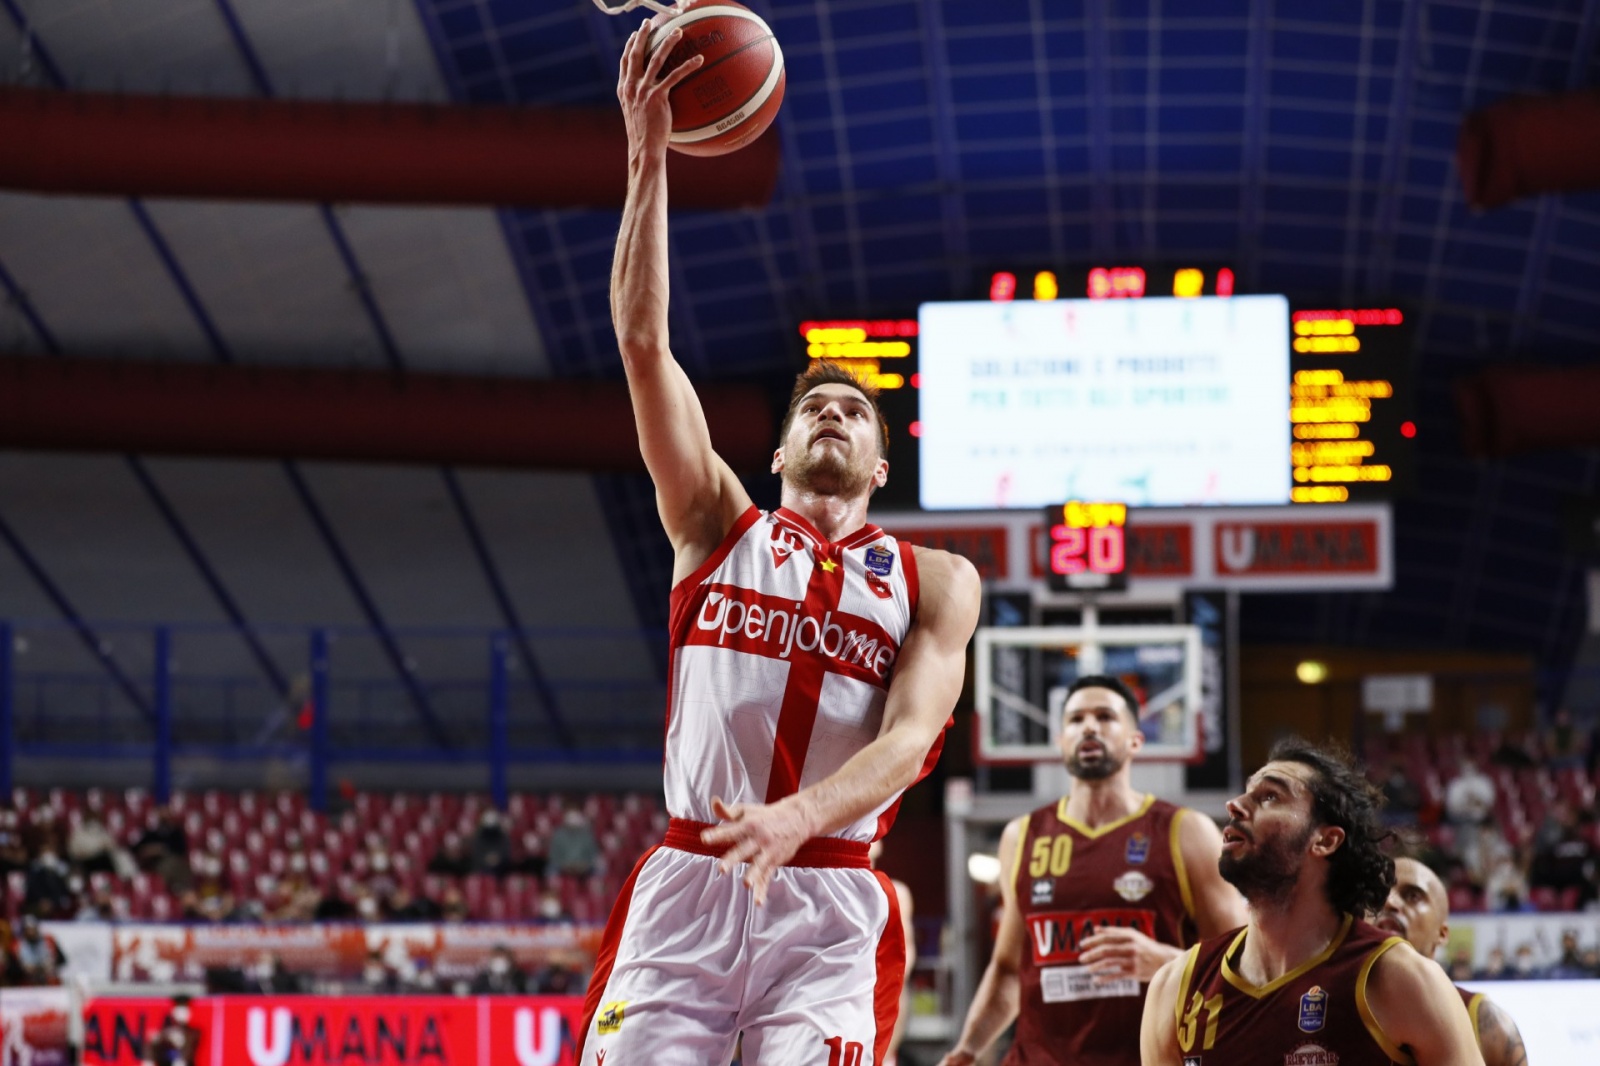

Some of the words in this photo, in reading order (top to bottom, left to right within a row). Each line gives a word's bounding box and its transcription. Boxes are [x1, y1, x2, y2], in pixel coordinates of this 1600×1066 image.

[716, 111, 745, 132] BG4500
[1050, 523, 1125, 574] 20
[1221, 528, 1366, 569] UMANA
[1029, 834, 1073, 878] 50
[1033, 917, 1140, 956] UMA
[1177, 990, 1224, 1053] 31
[1303, 1003, 1322, 1012] LBA
[247, 1006, 446, 1066] UMANA
[824, 1036, 863, 1066] 10
[1284, 1052, 1337, 1066] REYER
